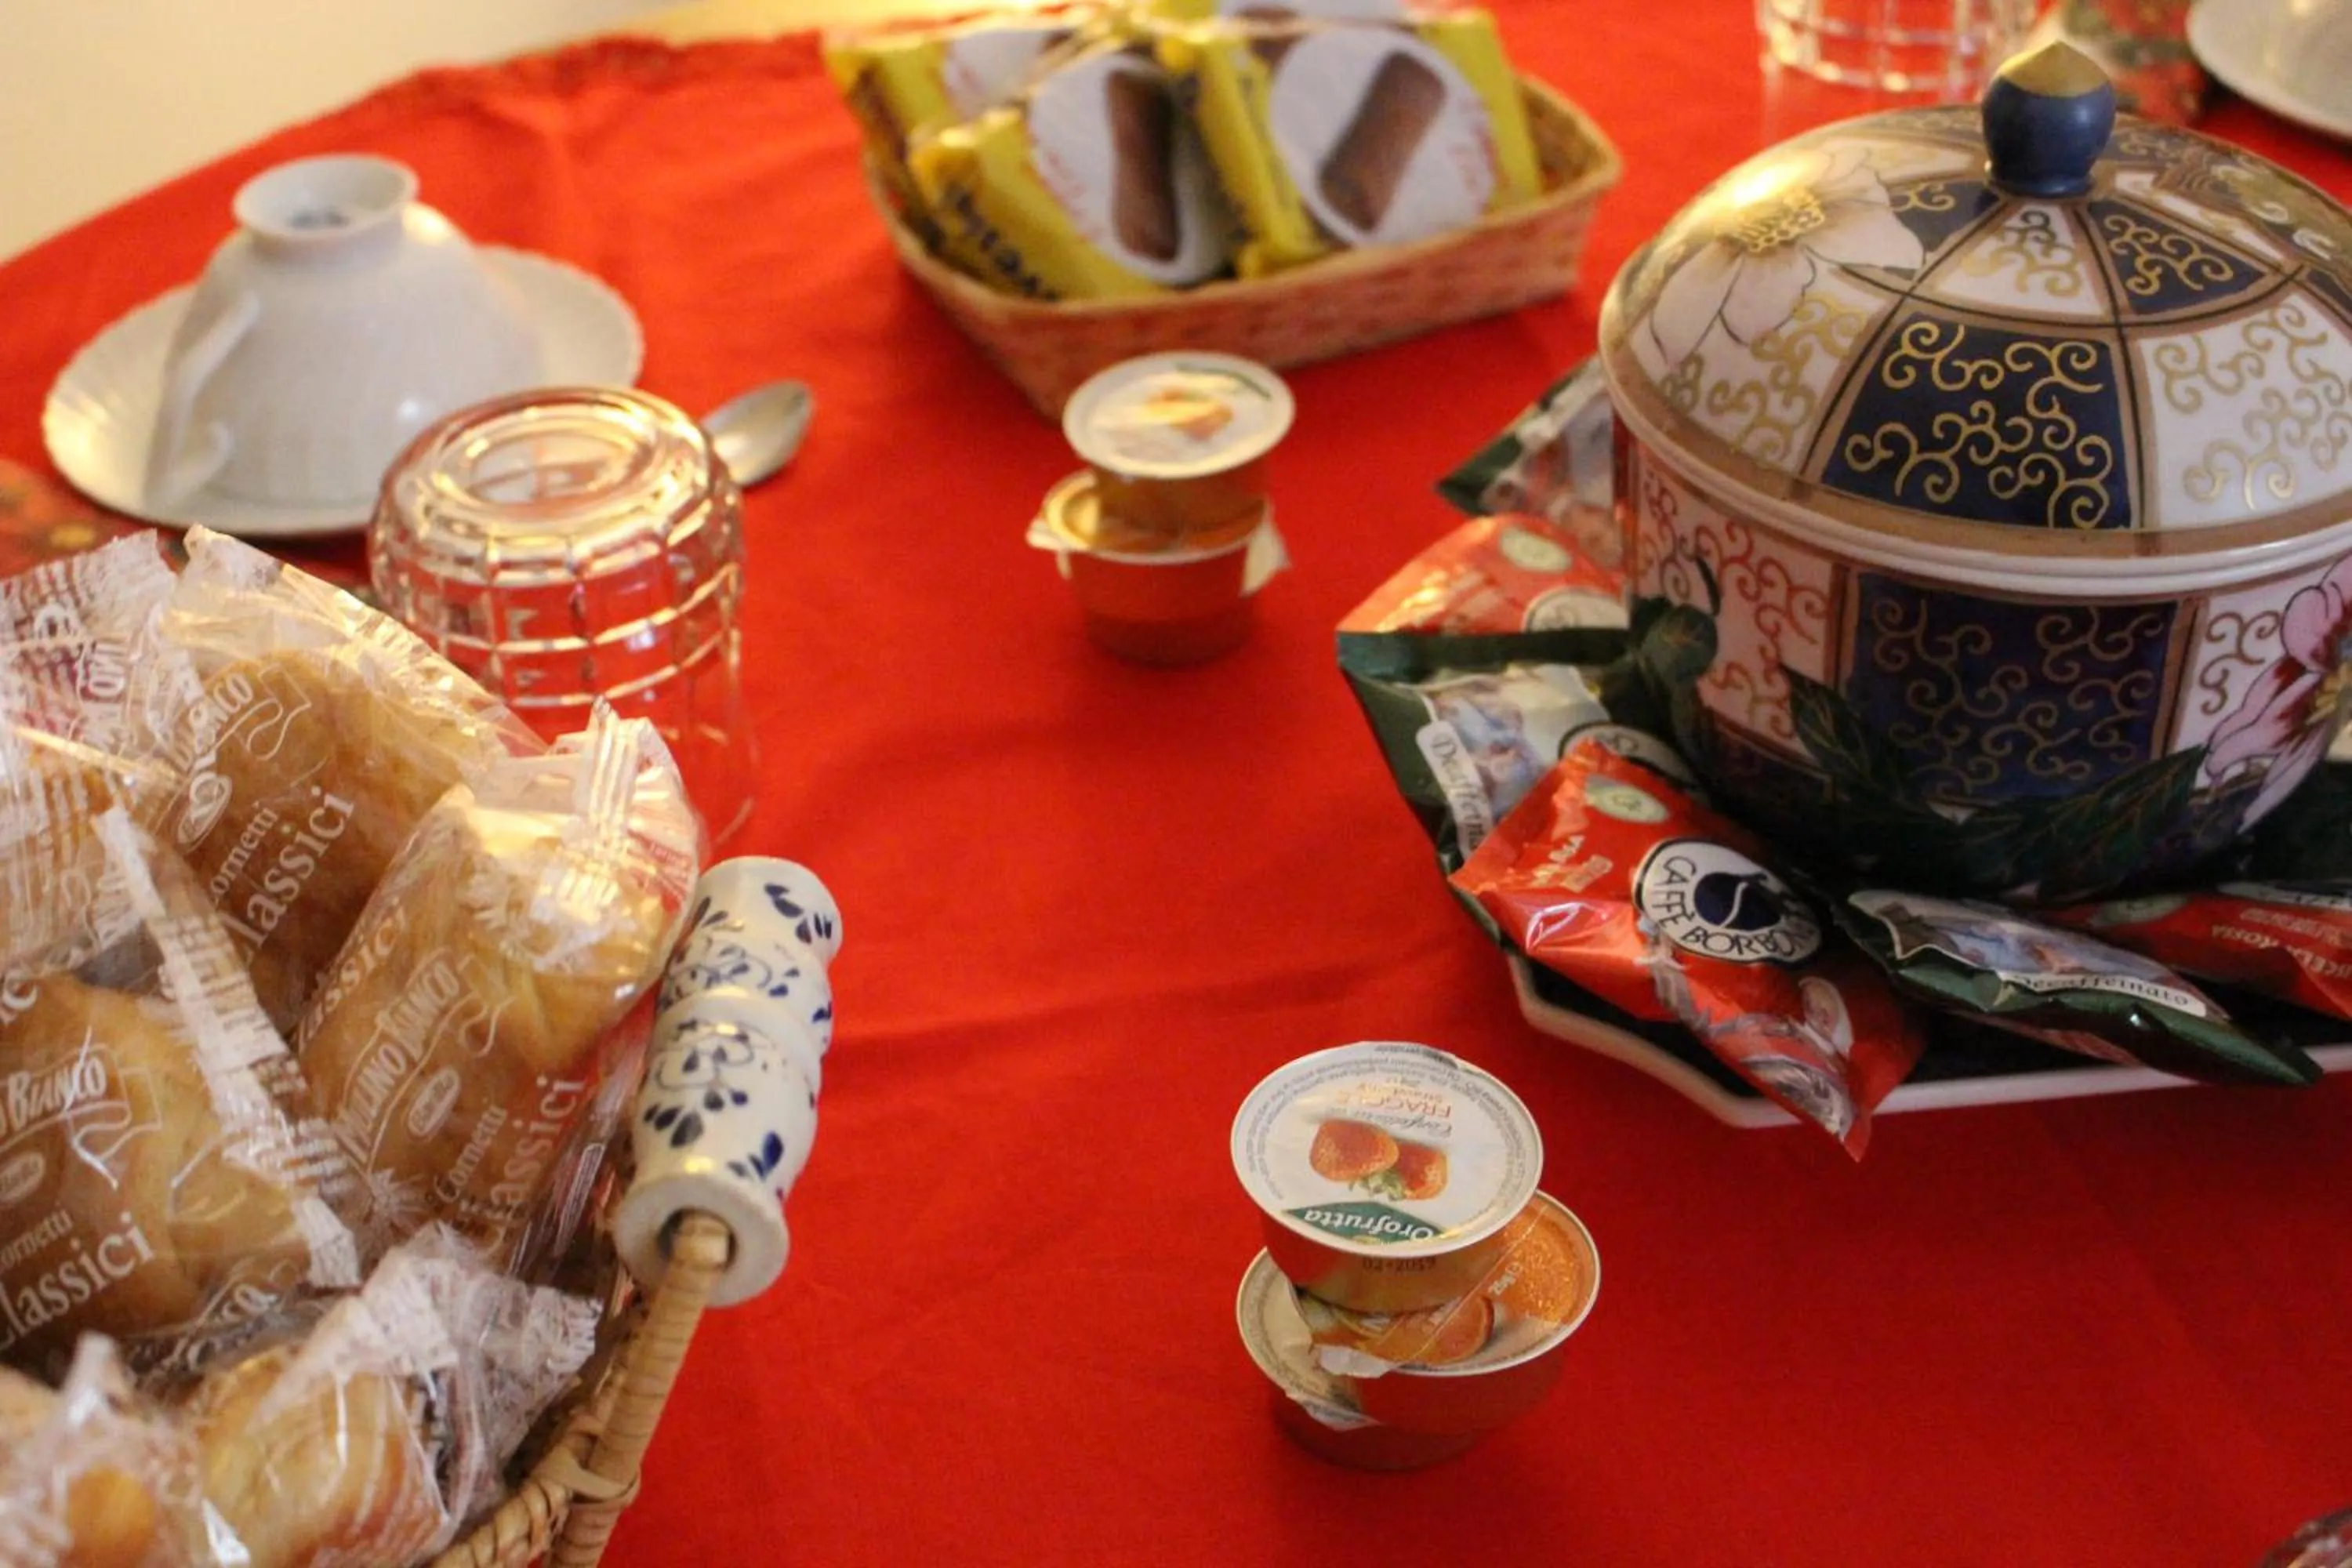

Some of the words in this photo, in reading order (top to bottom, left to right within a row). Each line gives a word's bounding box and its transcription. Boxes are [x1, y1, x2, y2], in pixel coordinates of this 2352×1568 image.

[209, 800, 279, 907] ornetti
[216, 785, 355, 964] lassici
[0, 1200, 73, 1272] ornetti
[1304, 1208, 1434, 1243] Orofrutta
[0, 1211, 155, 1350] lassici
